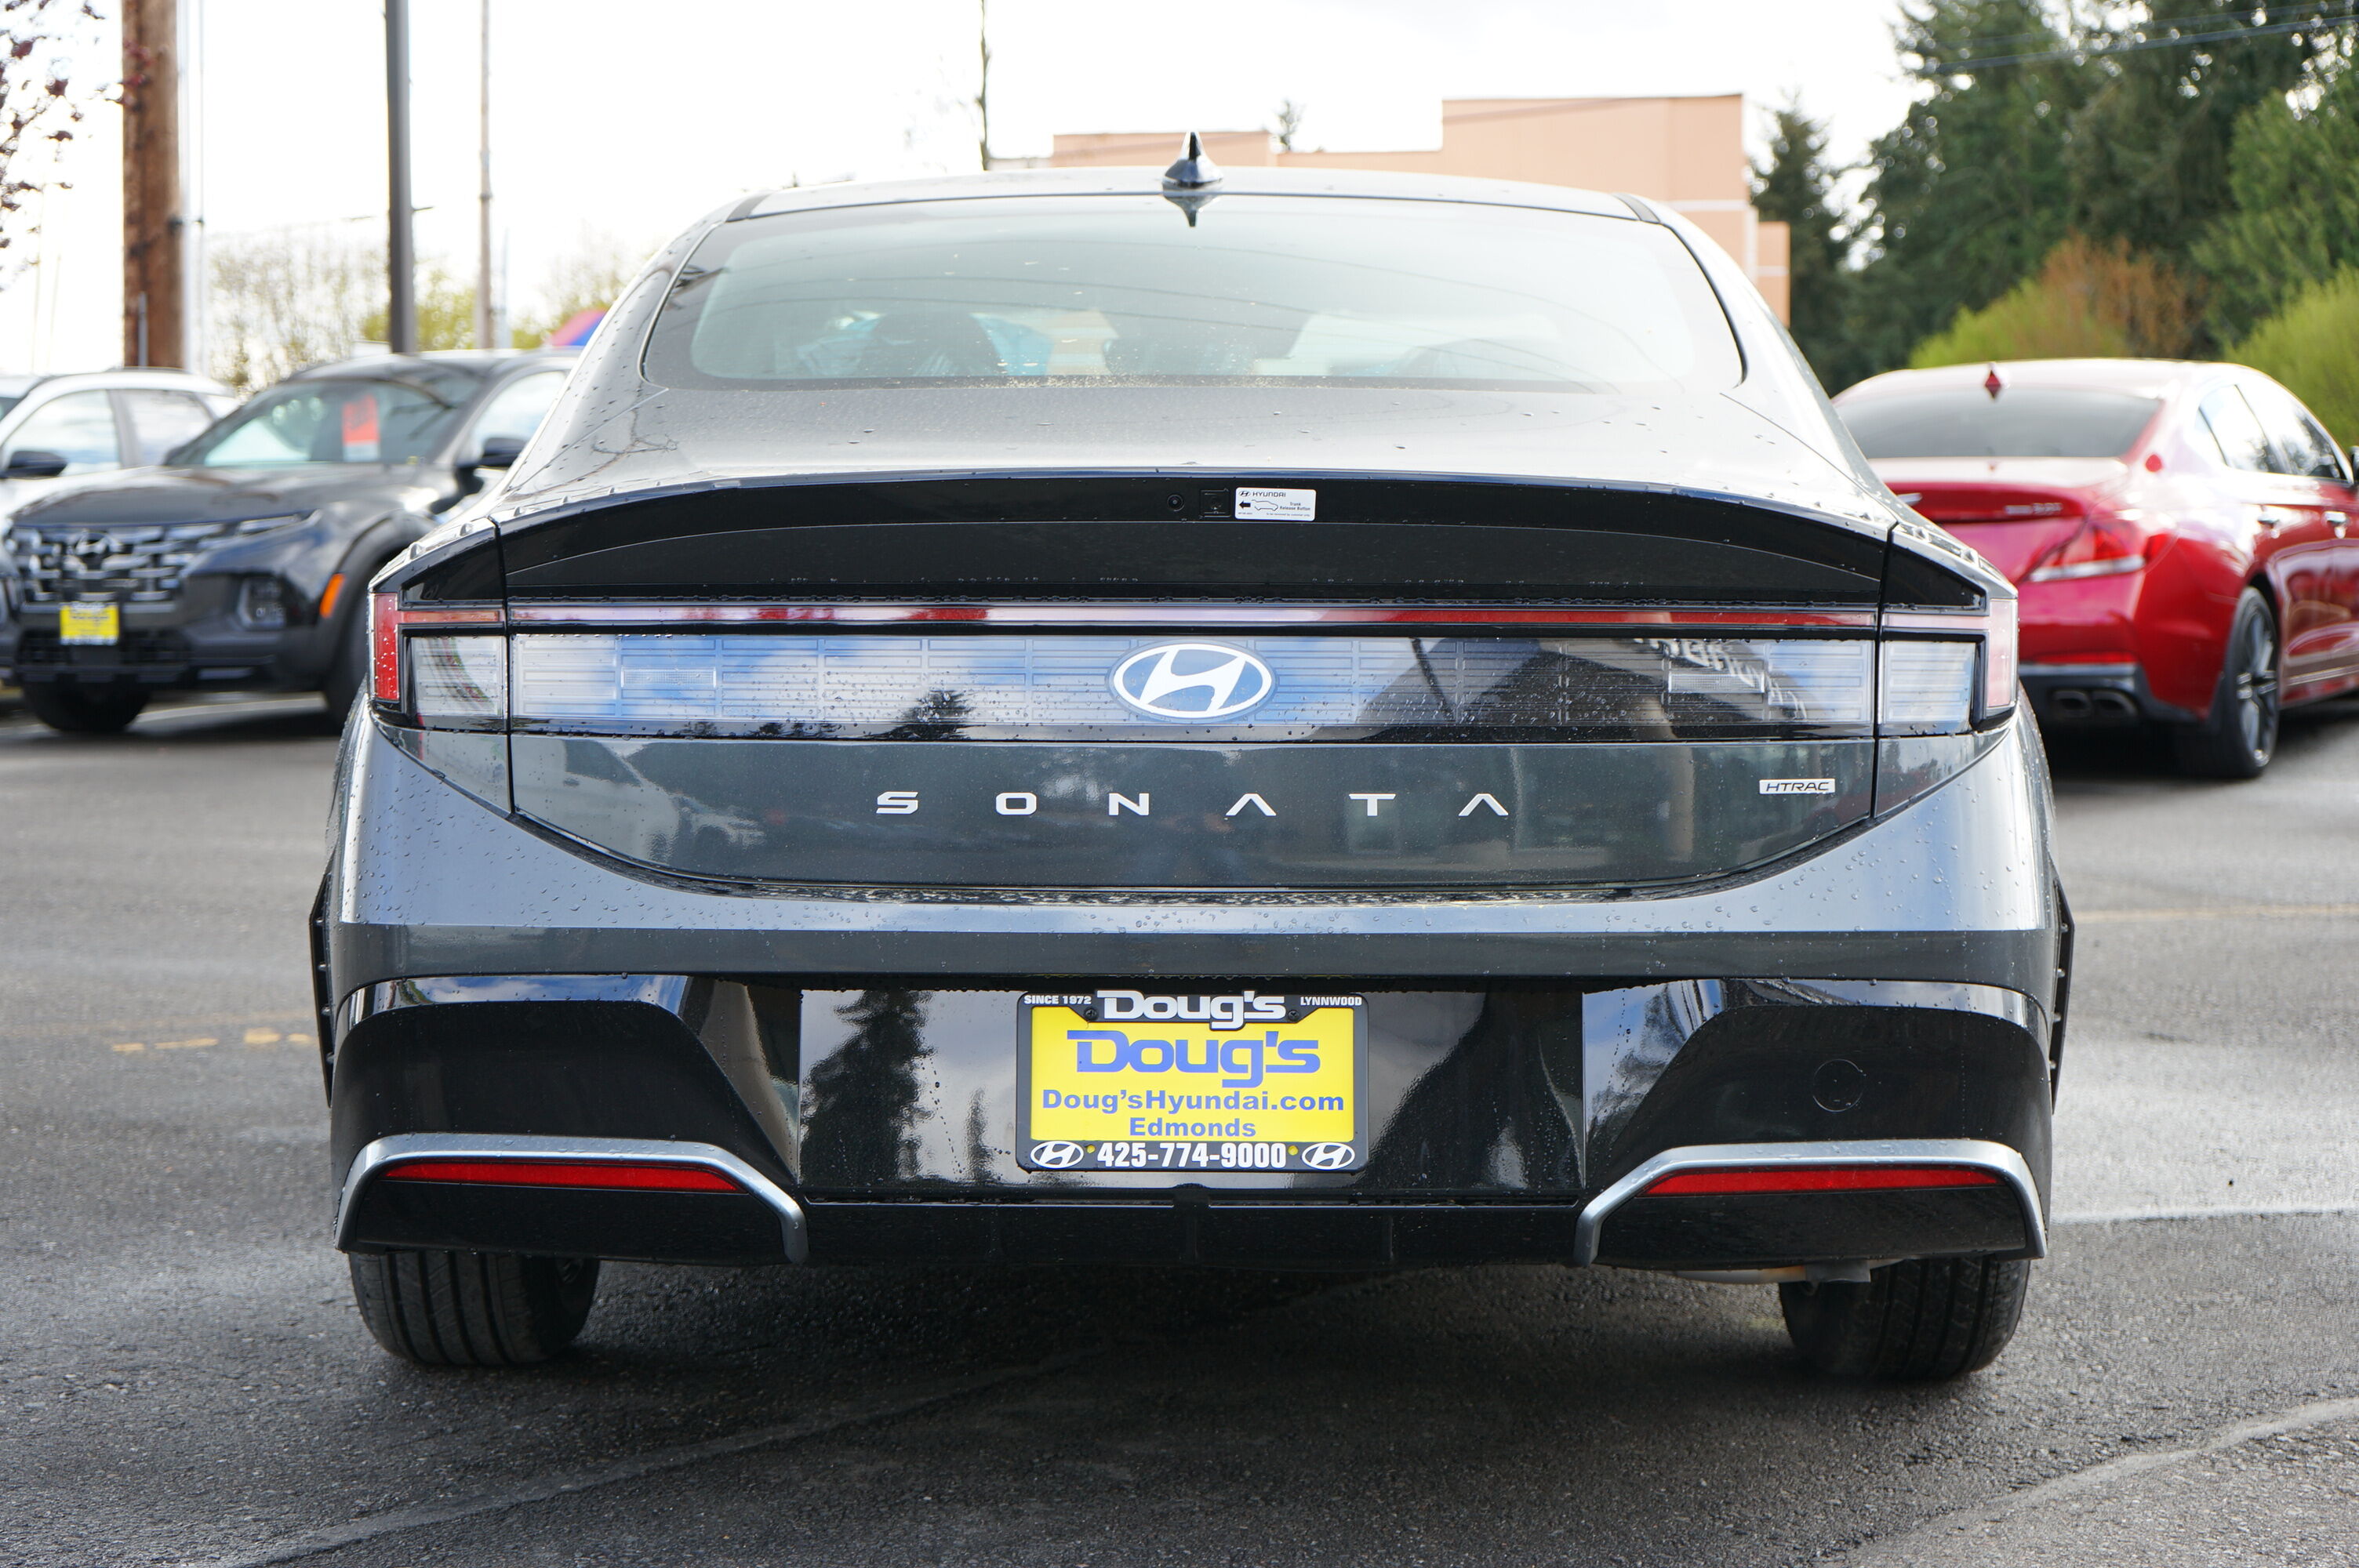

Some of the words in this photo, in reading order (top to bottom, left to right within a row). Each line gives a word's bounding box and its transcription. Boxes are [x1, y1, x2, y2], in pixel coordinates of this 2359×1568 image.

[1766, 782, 1829, 792] HTRAC
[876, 791, 1509, 816] SONATA
[1023, 995, 1059, 1004] SINCE
[1062, 996, 1092, 1005] 1972
[1096, 990, 1286, 1029] Doug's
[1300, 996, 1362, 1007] LYNNWOOD
[1067, 1030, 1321, 1087] Doug's
[1042, 1089, 1344, 1114] Doug'sHyundai.com
[1129, 1117, 1256, 1137] Edmonds
[1097, 1142, 1286, 1168] 425-774-9000
